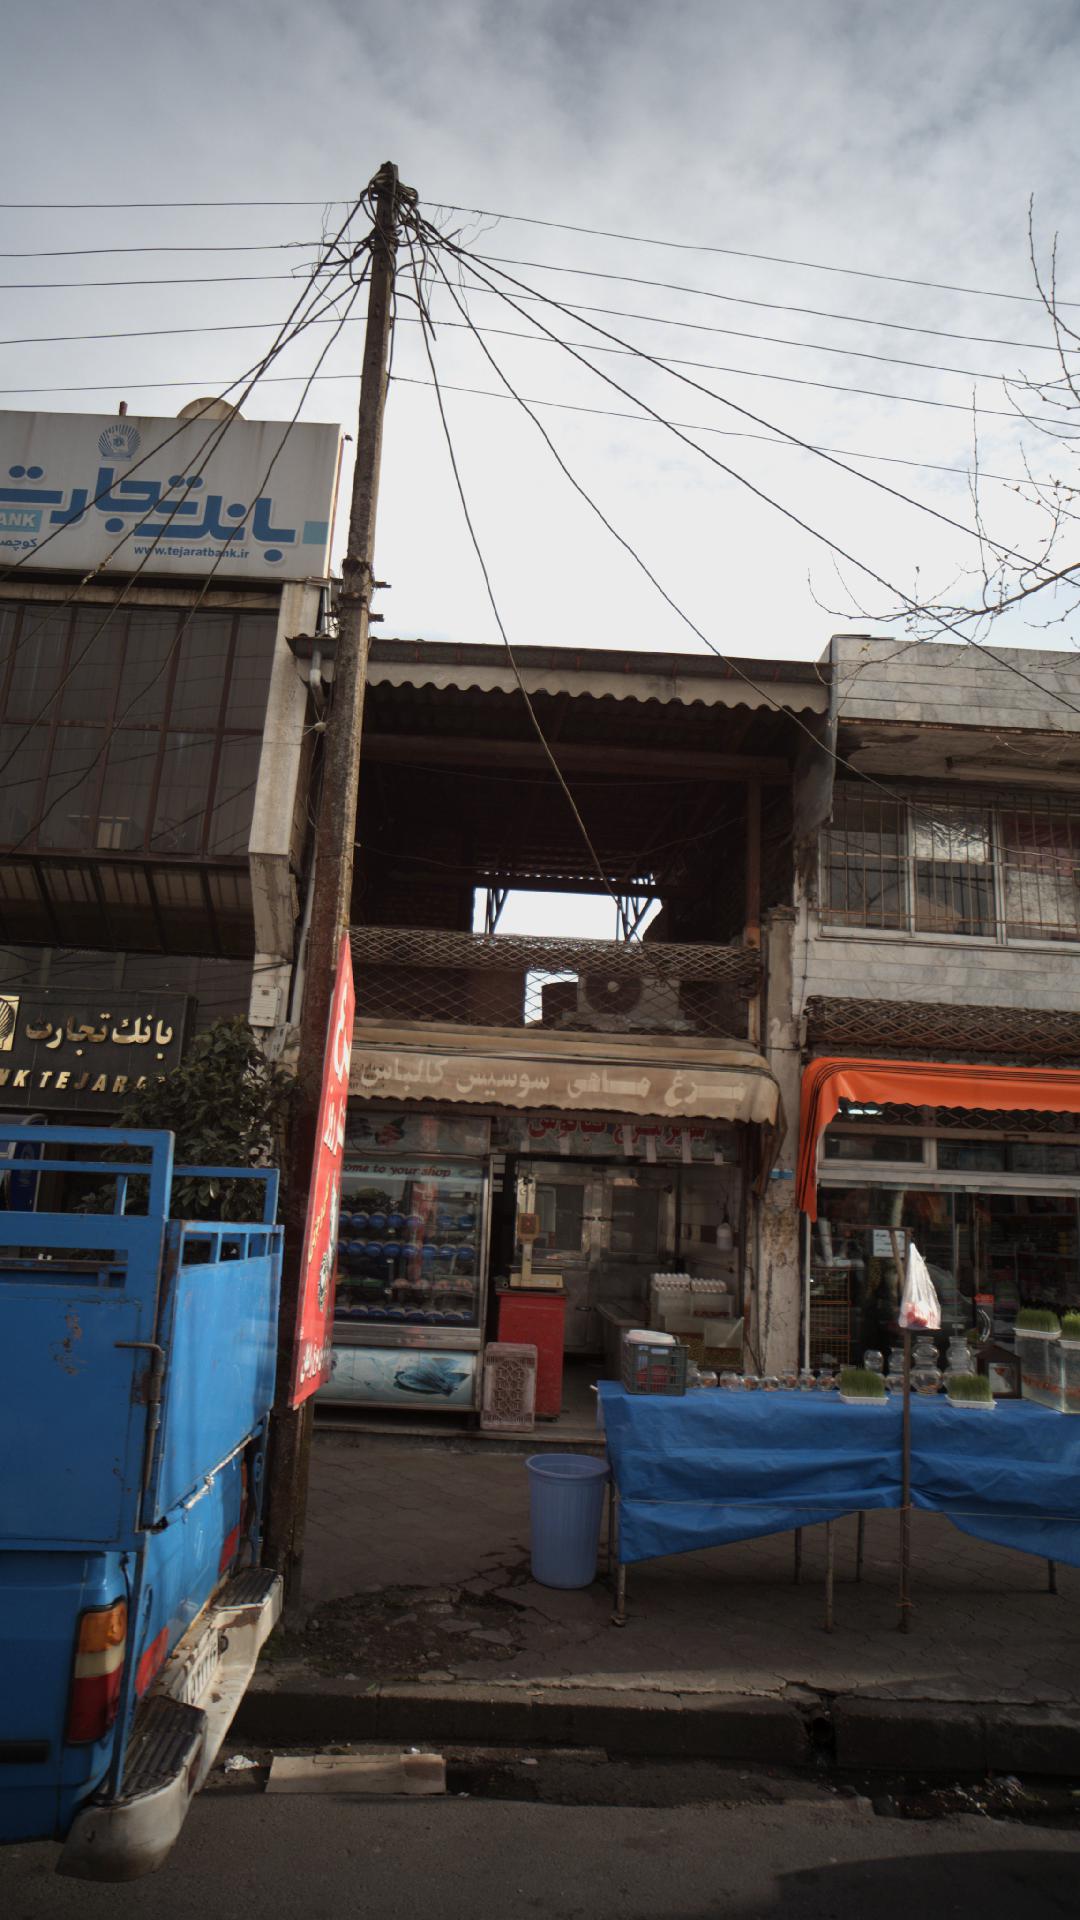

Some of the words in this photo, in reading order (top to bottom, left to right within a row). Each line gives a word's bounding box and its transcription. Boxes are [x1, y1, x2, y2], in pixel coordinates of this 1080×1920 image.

[0, 464, 205, 534] تجارت
[134, 543, 250, 559] www.tejaratbank.ir
[25, 1012, 111, 1057] تجارت
[360, 1058, 448, 1092] کالباس
[456, 1072, 550, 1097] سوسیس
[567, 1069, 652, 1098] ماهی
[664, 1069, 748, 1107] مرغ
[373, 1164, 386, 1173] to
[390, 1166, 418, 1175] your
[421, 1166, 451, 1179] shop
